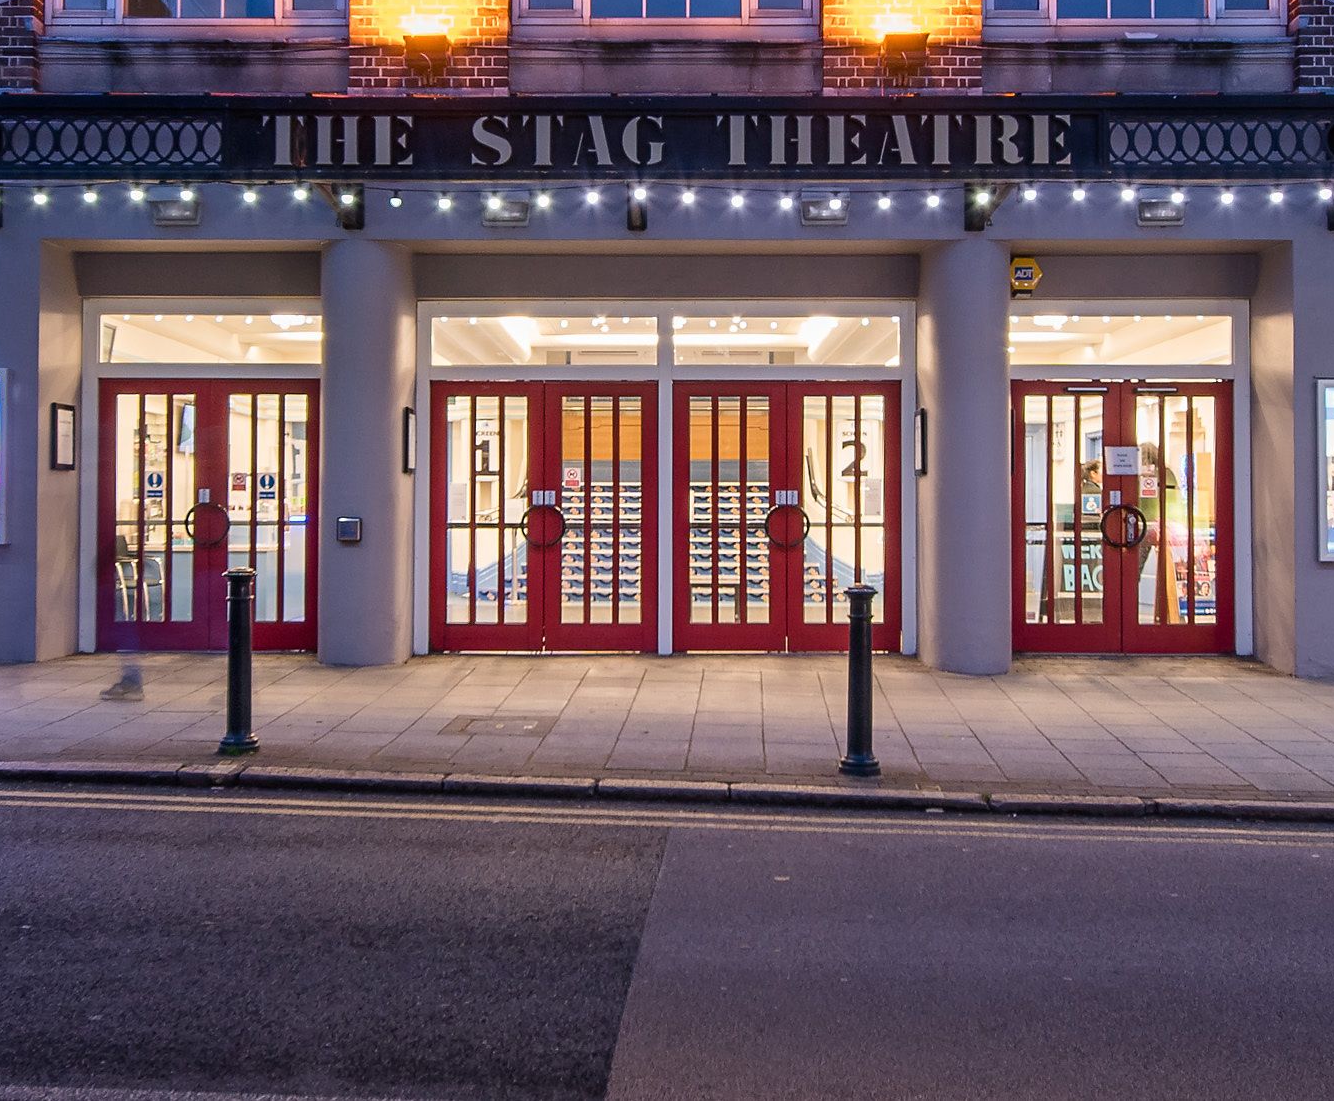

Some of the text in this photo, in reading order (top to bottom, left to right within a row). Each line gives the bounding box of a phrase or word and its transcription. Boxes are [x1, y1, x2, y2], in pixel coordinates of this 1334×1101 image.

[262, 115, 1071, 166] THE STAG THEATRE
[1015, 269, 1034, 278] ADT
[474, 440, 499, 475] 1
[841, 440, 868, 476] 2
